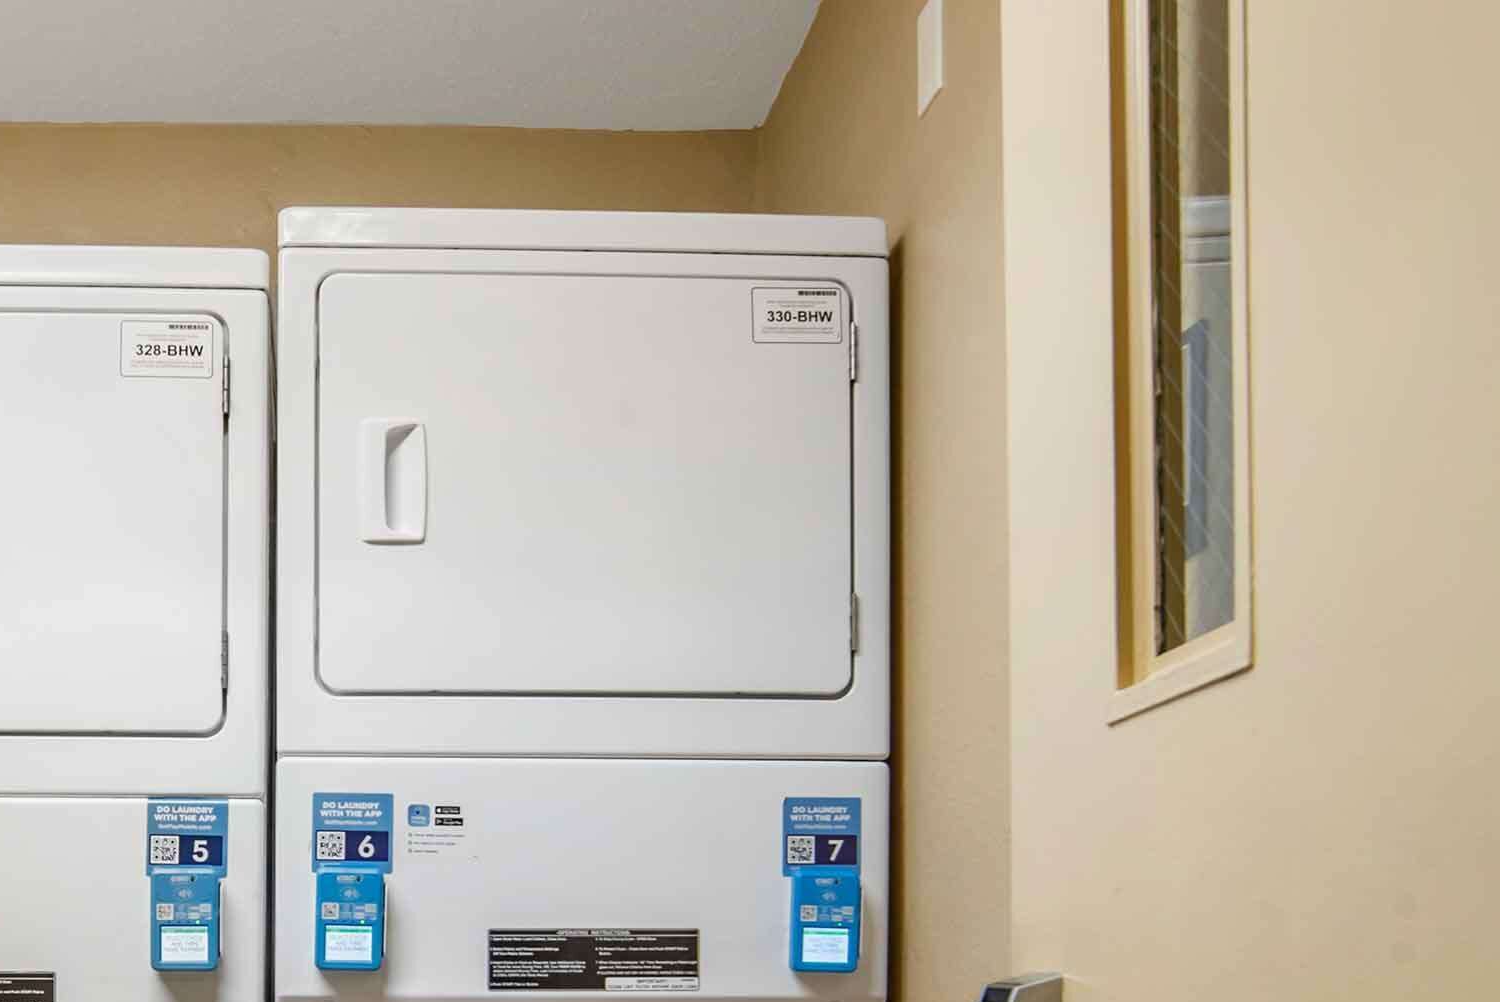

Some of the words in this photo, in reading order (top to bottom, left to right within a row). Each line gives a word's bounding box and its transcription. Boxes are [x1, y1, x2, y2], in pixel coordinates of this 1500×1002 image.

[767, 310, 833, 322] 330-BHW
[135, 344, 204, 356] 328-BHW
[192, 840, 209, 863] 5
[357, 835, 375, 858] 6
[827, 840, 844, 862] 7
